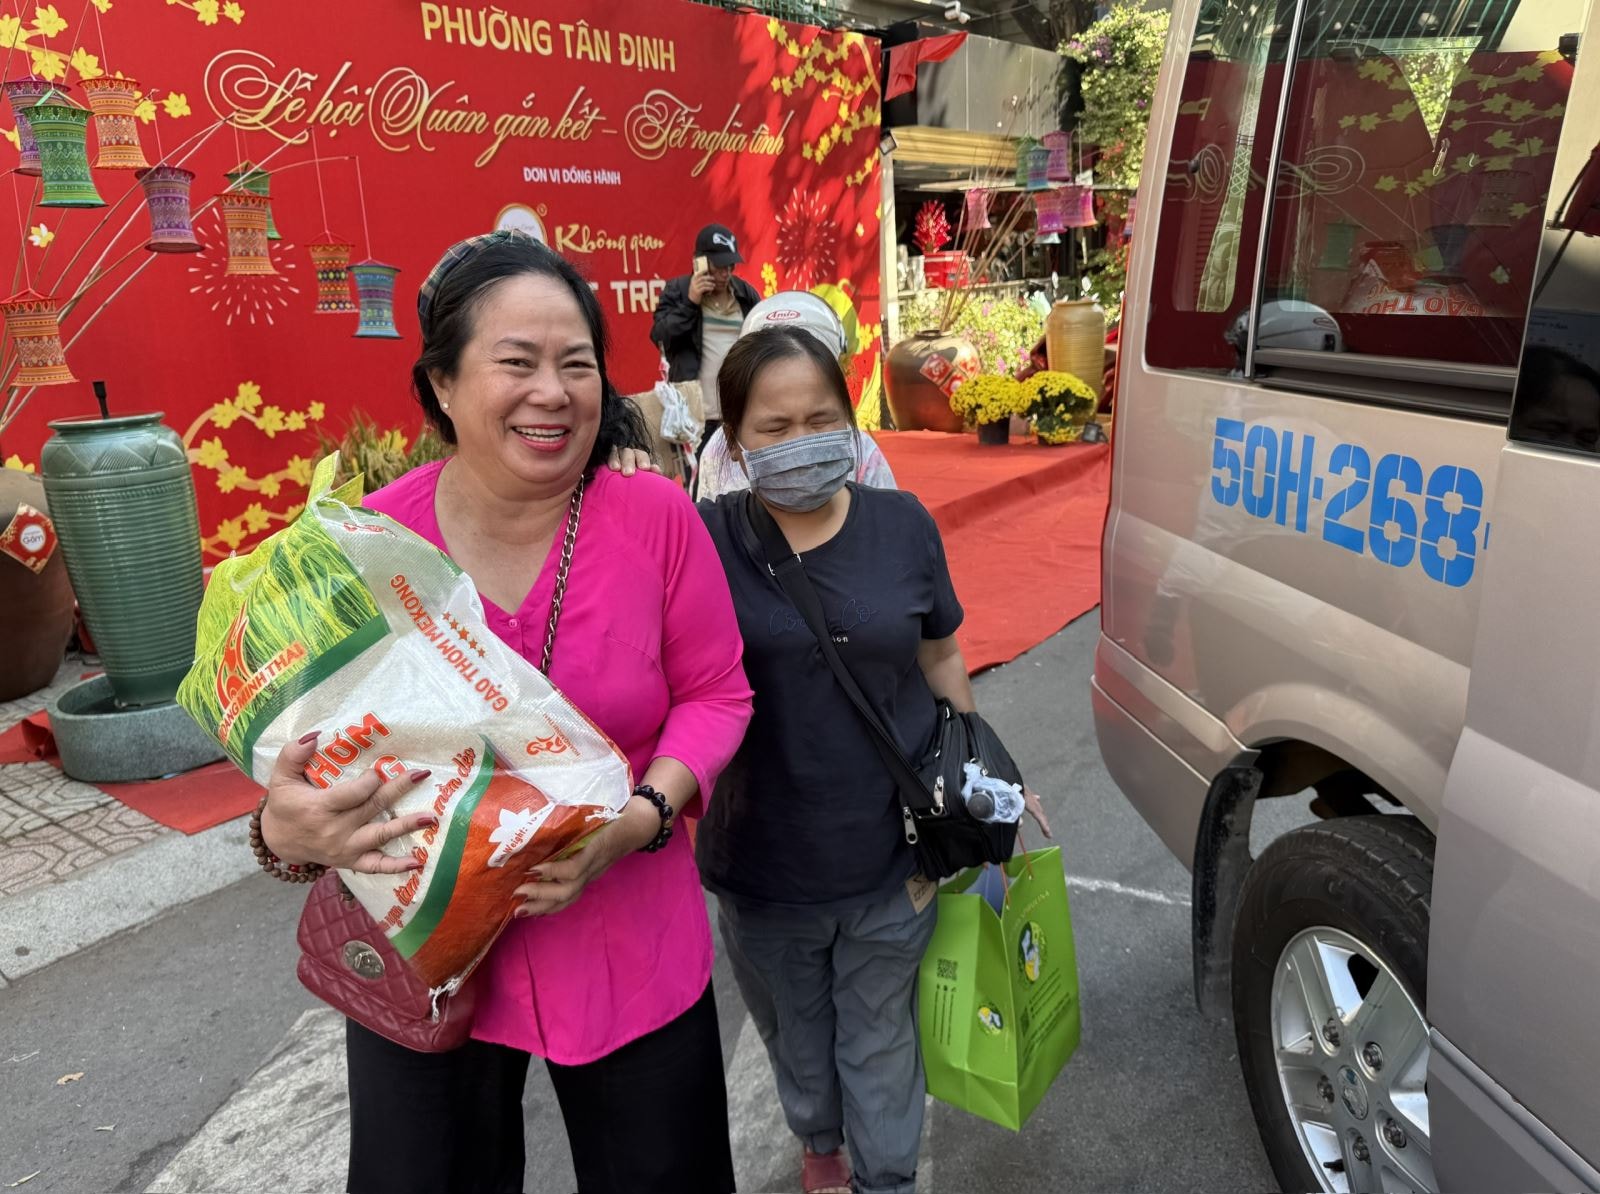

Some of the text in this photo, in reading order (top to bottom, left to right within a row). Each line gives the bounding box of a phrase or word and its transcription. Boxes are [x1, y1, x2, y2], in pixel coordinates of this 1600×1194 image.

[421, 2, 676, 72] PHƯỜNG TÂN ĐỊNH
[204, 49, 318, 144] Lễ
[307, 62, 373, 138] hội
[369, 67, 490, 152] Xuân
[475, 92, 551, 168] gắn
[551, 86, 607, 141] kết
[625, 89, 702, 160] Tết
[691, 103, 747, 177] nghĩa
[749, 110, 795, 156] tình
[555, 223, 629, 274] Không
[390, 574, 508, 711] GẠO THƠM MEKONG
[303, 711, 392, 790] HƠM
